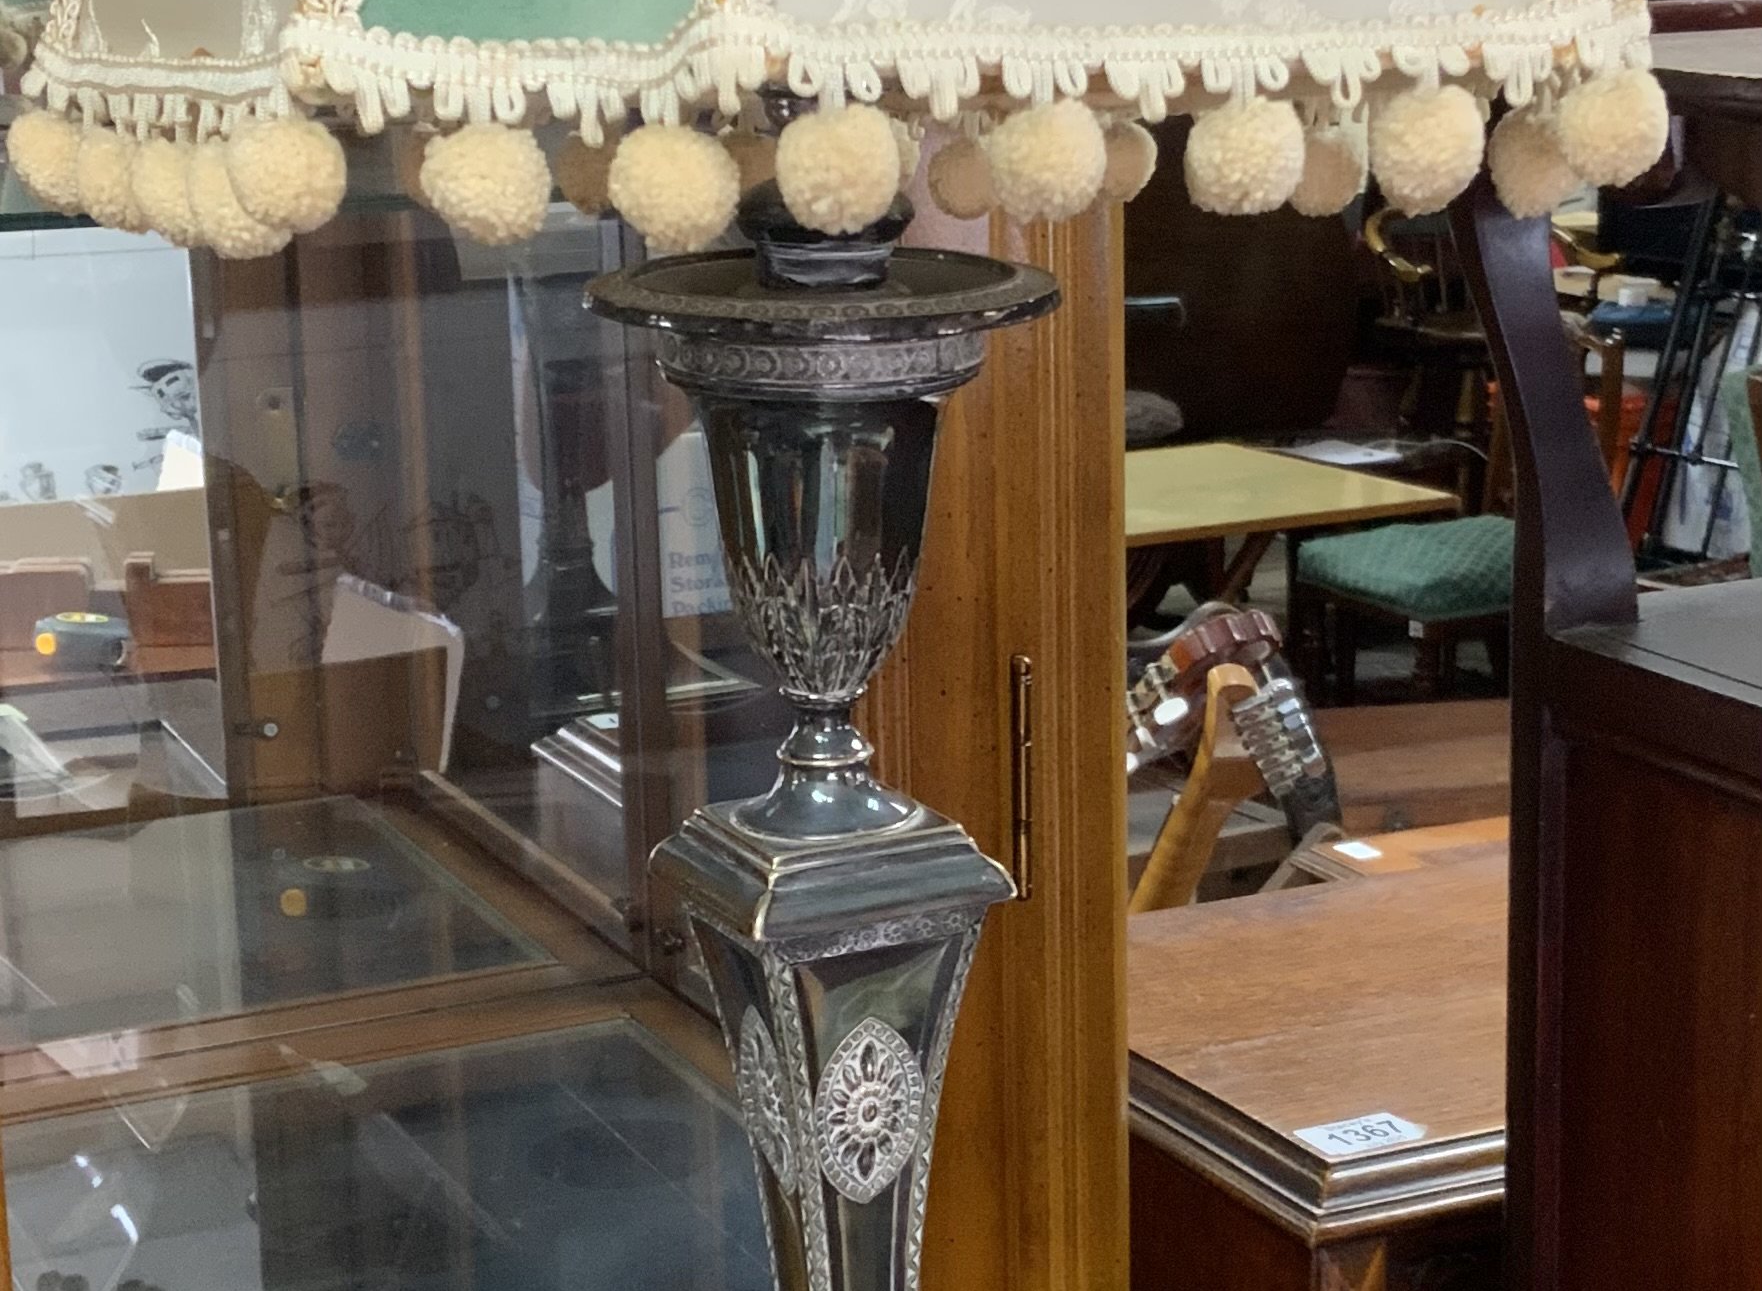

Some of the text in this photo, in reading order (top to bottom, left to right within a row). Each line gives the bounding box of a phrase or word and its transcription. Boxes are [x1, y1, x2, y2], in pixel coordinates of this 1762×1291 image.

[668, 552, 717, 568] Rem
[670, 576, 726, 593] Stora
[1327, 1119, 1402, 1146] 1367
